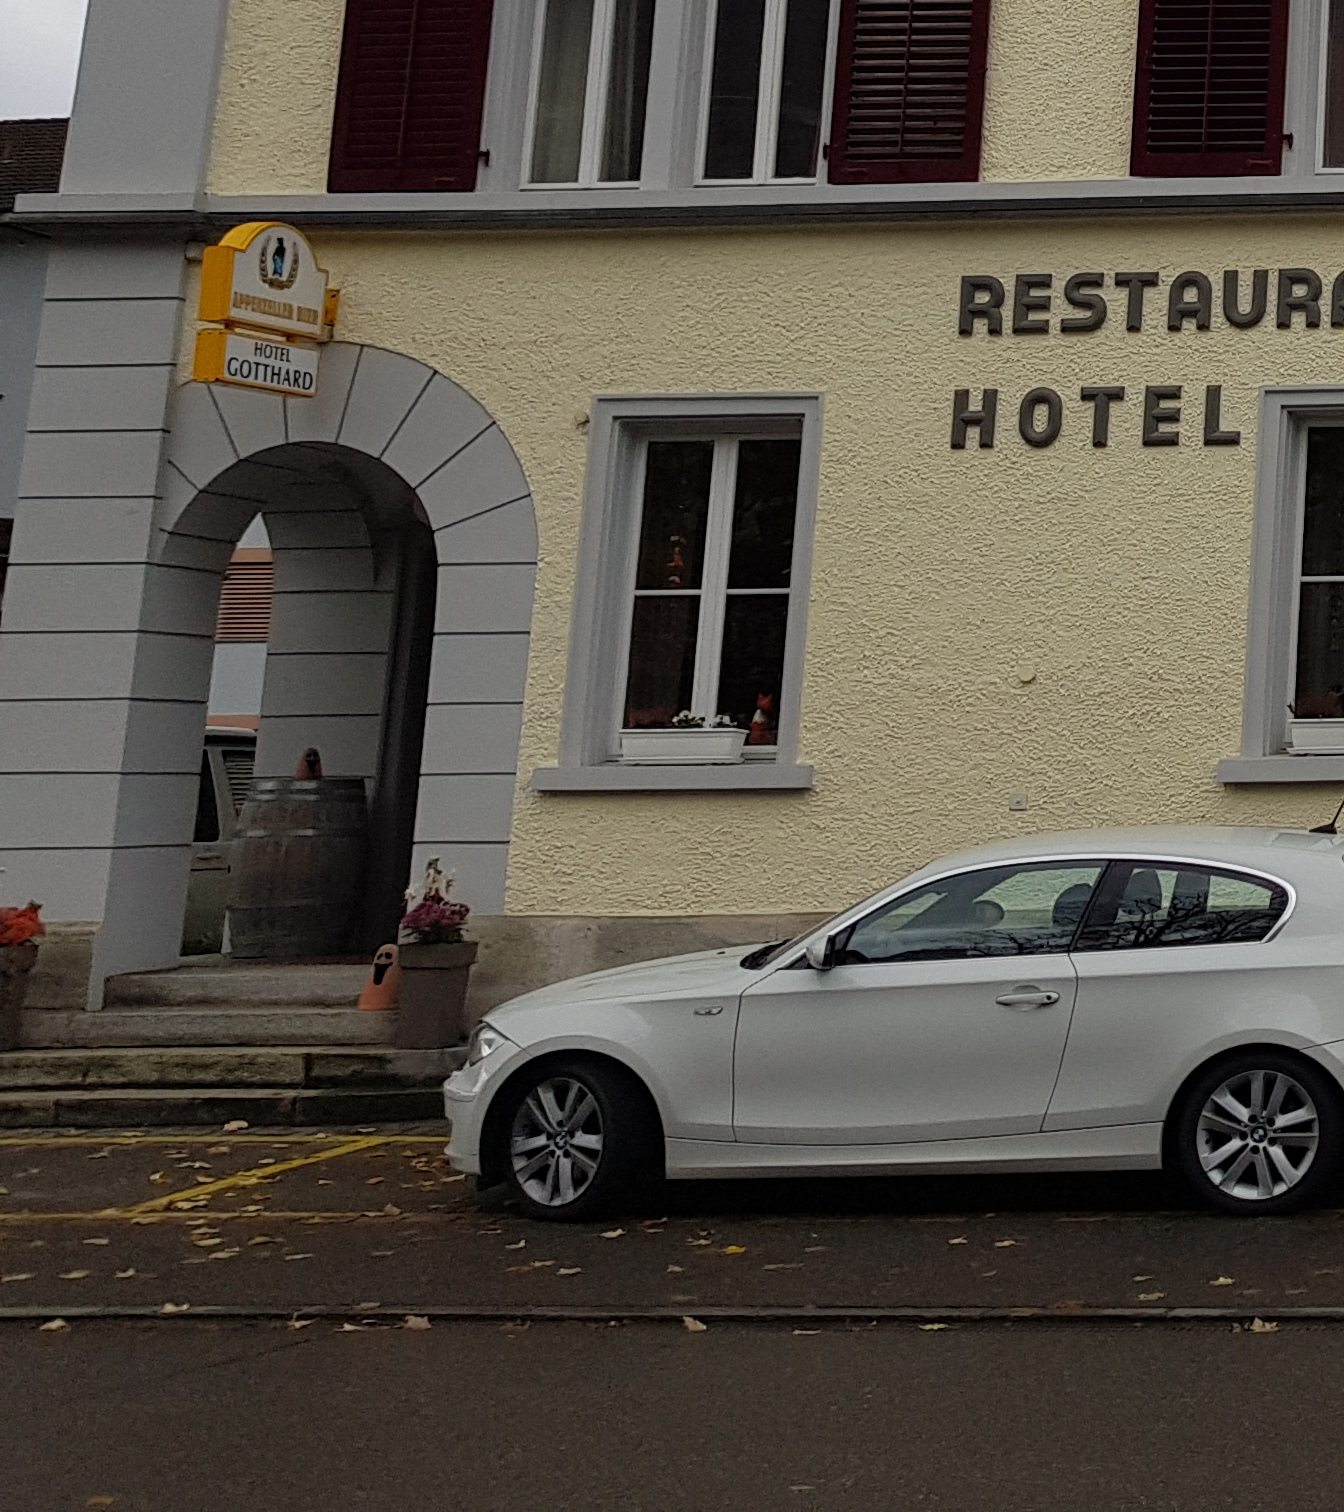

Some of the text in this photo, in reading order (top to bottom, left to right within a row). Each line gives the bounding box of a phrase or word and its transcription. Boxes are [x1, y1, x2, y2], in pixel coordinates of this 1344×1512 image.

[254, 342, 291, 363] HOTEL
[227, 357, 313, 390] GOTTHARD
[951, 385, 1241, 449] HOTEL
